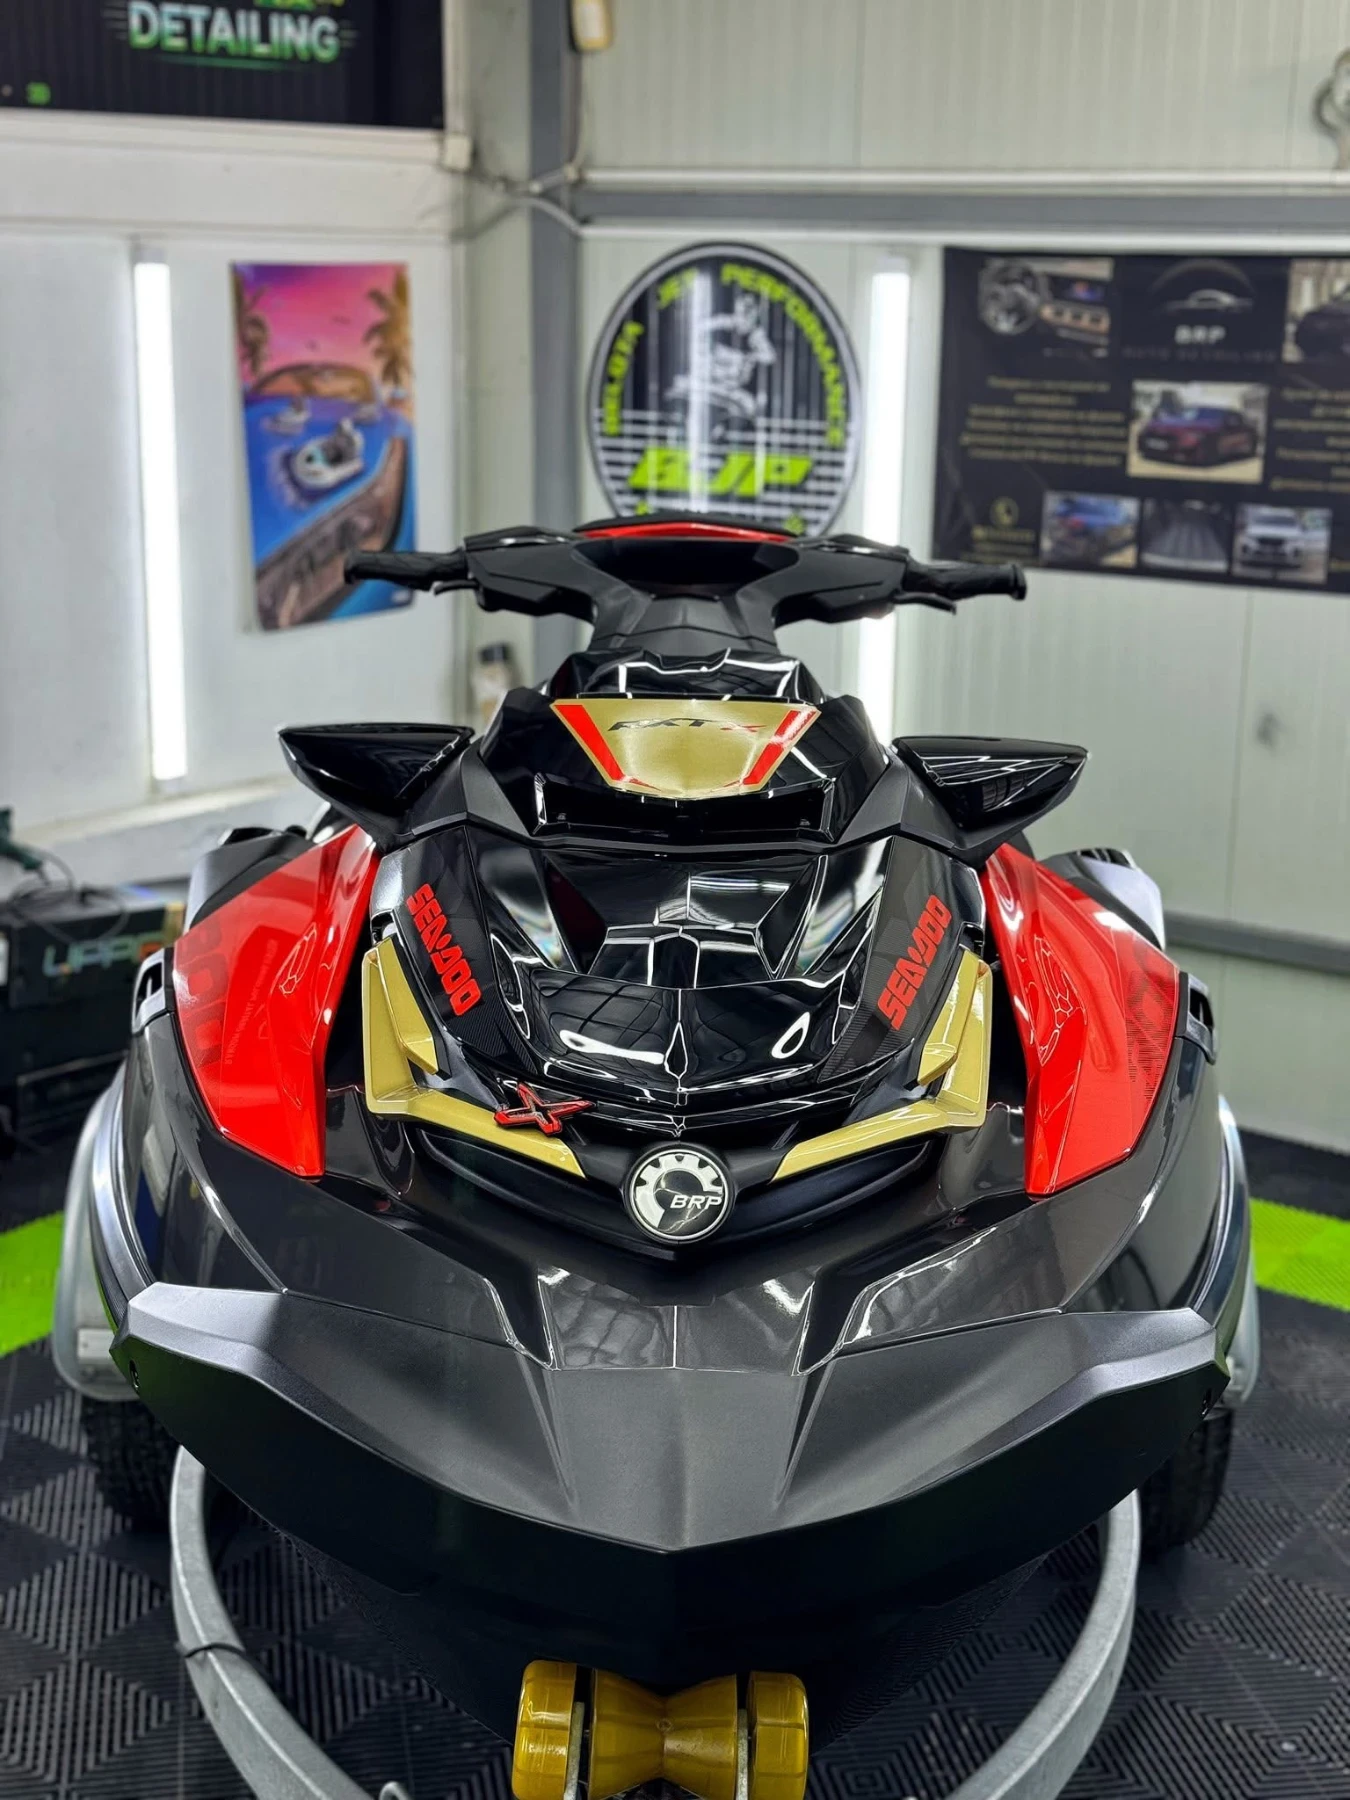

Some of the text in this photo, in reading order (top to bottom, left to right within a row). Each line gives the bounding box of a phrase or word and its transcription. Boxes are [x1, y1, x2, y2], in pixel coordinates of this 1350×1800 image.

[127, 0, 342, 63] DETAILING
[1174, 323, 1227, 345] BRP
[627, 446, 813, 498] BJP
[669, 1194, 723, 1210] BRP
